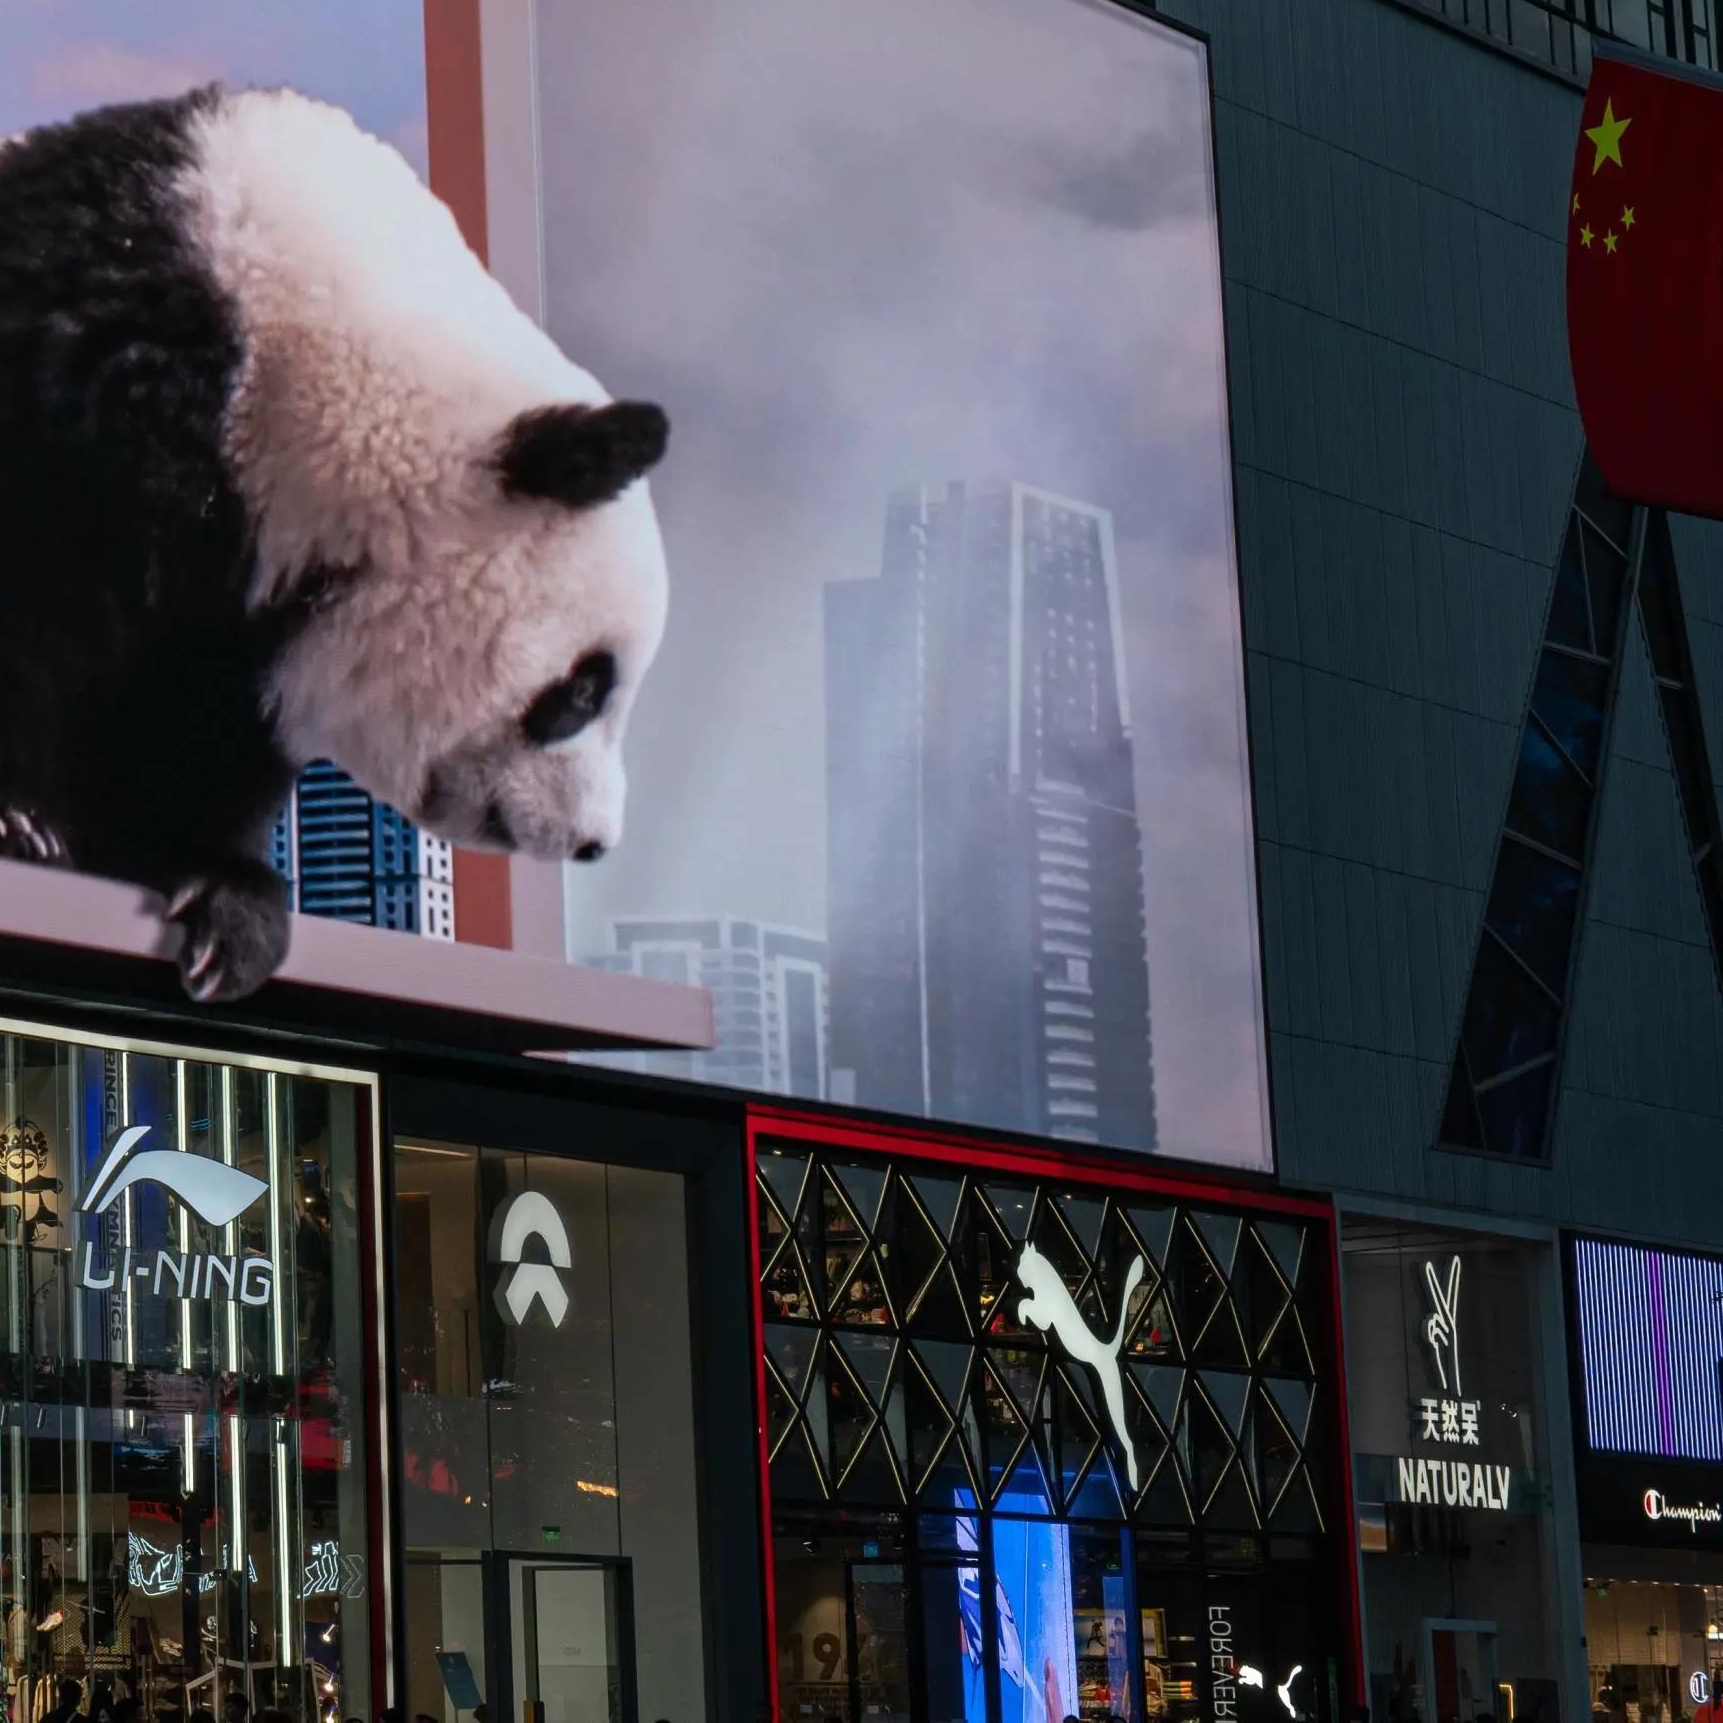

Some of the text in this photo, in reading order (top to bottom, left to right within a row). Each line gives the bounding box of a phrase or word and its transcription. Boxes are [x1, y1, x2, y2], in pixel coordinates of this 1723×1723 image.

[82, 1240, 273, 1306] LI-NING
[1421, 1398, 1480, 1445] 天然呆
[1398, 1457, 1510, 1510] NATURALV
[1644, 1489, 1722, 1533] Champion
